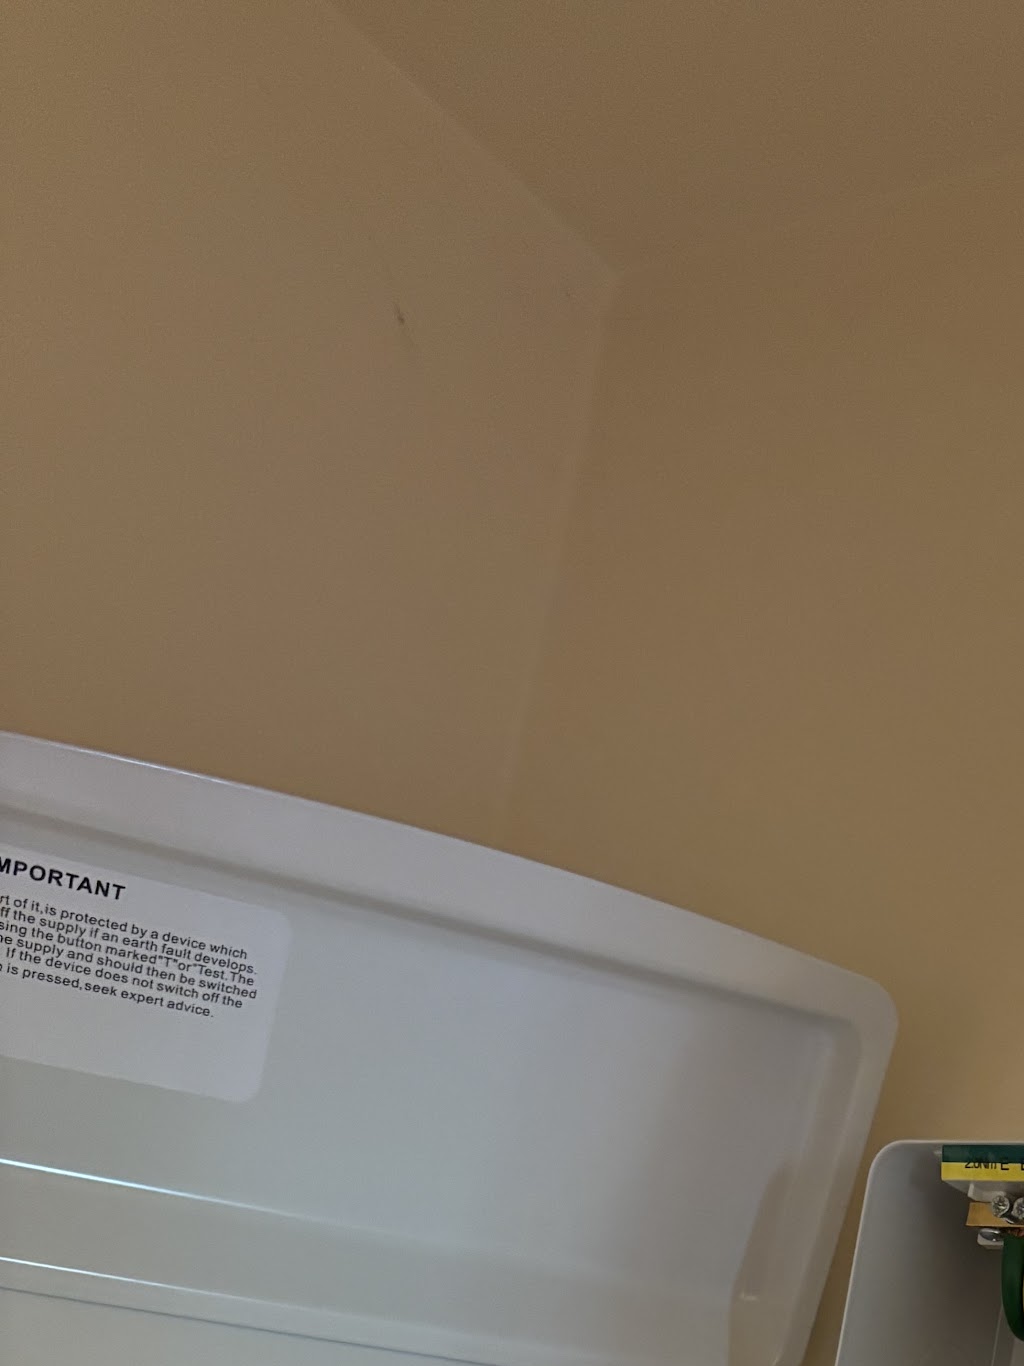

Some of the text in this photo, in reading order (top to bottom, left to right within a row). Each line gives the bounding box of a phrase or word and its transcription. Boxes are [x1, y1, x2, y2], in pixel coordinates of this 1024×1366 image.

[13, 910, 257, 975] the supply if an earth fault develops.
[14, 899, 28, 907] of
[60, 909, 127, 932] protected
[131, 924, 148, 939] by
[151, 931, 158, 940] a
[162, 932, 206, 950] device
[210, 943, 247, 960] which
[31, 927, 53, 941] the
[58, 933, 101, 952] button
[7, 963, 18, 975] is
[121, 990, 164, 1007] expert
[166, 999, 214, 1017] advice.
[17, 939, 257, 999] supply and should then be switched
[19, 950, 41, 964] the
[45, 956, 91, 975] device
[95, 968, 128, 984] does
[132, 976, 154, 989] not
[156, 981, 199, 999] switch
[202, 991, 220, 1004] off
[222, 994, 243, 1009] the
